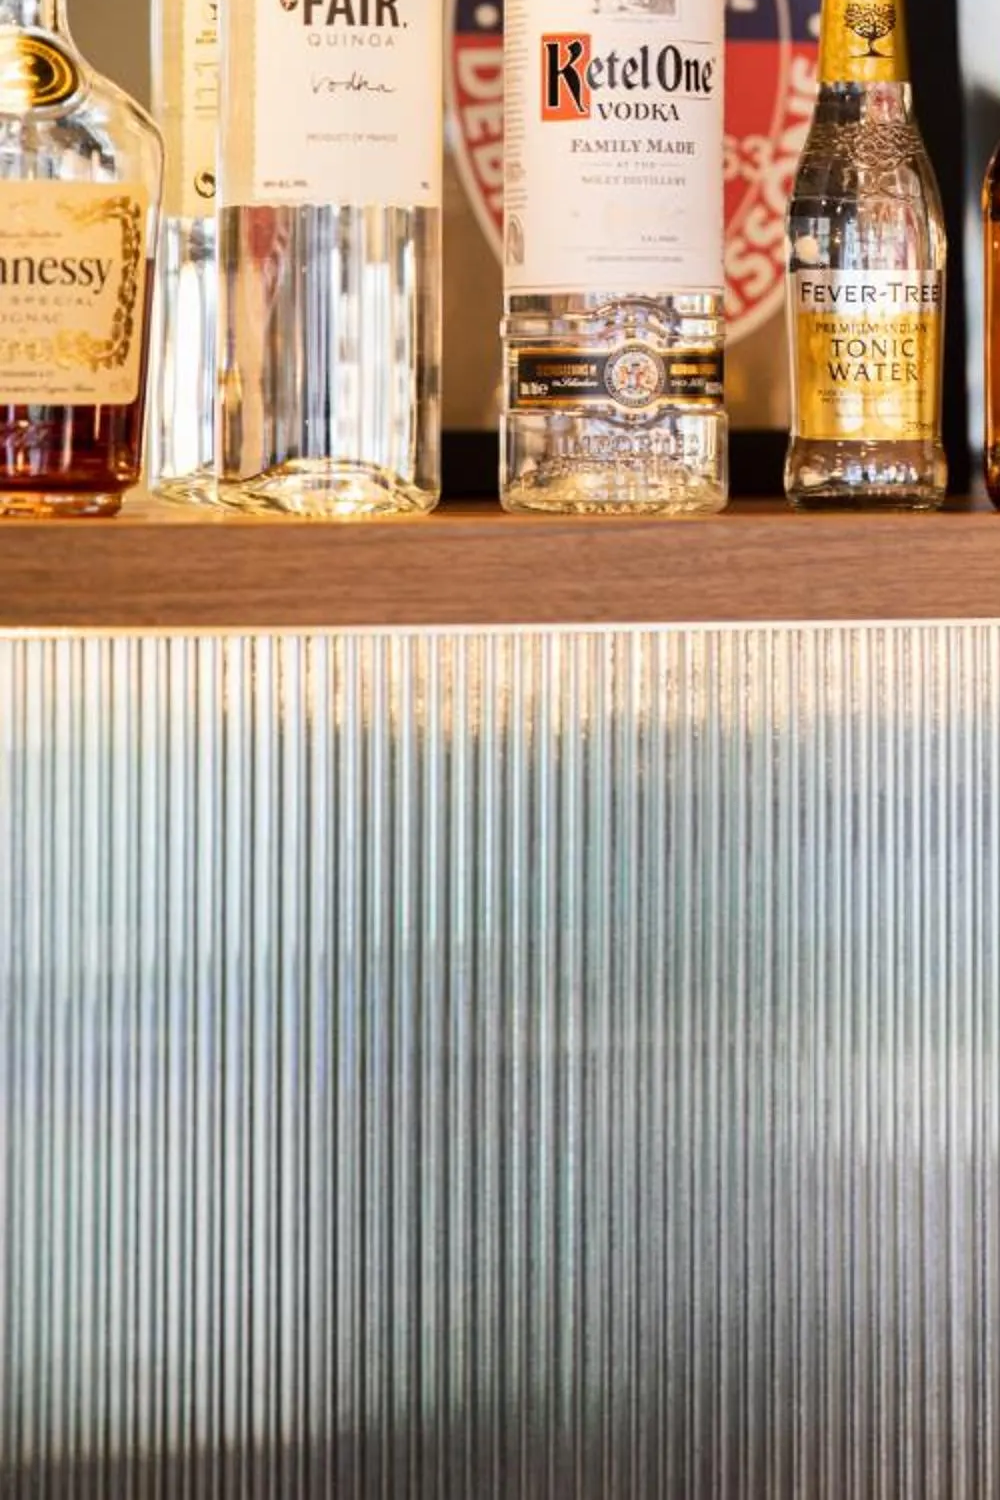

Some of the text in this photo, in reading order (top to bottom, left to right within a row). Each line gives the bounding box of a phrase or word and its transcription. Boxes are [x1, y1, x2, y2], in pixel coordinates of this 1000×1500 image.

[306, 33, 396, 47] QUINOA
[545, 41, 714, 113] Ketel One
[597, 102, 680, 121] VODKA
[571, 138, 696, 156] FAMILY MADE
[800, 282, 941, 304] FEVER-TREE
[831, 339, 915, 359] TONIC
[828, 362, 919, 381] WATER
